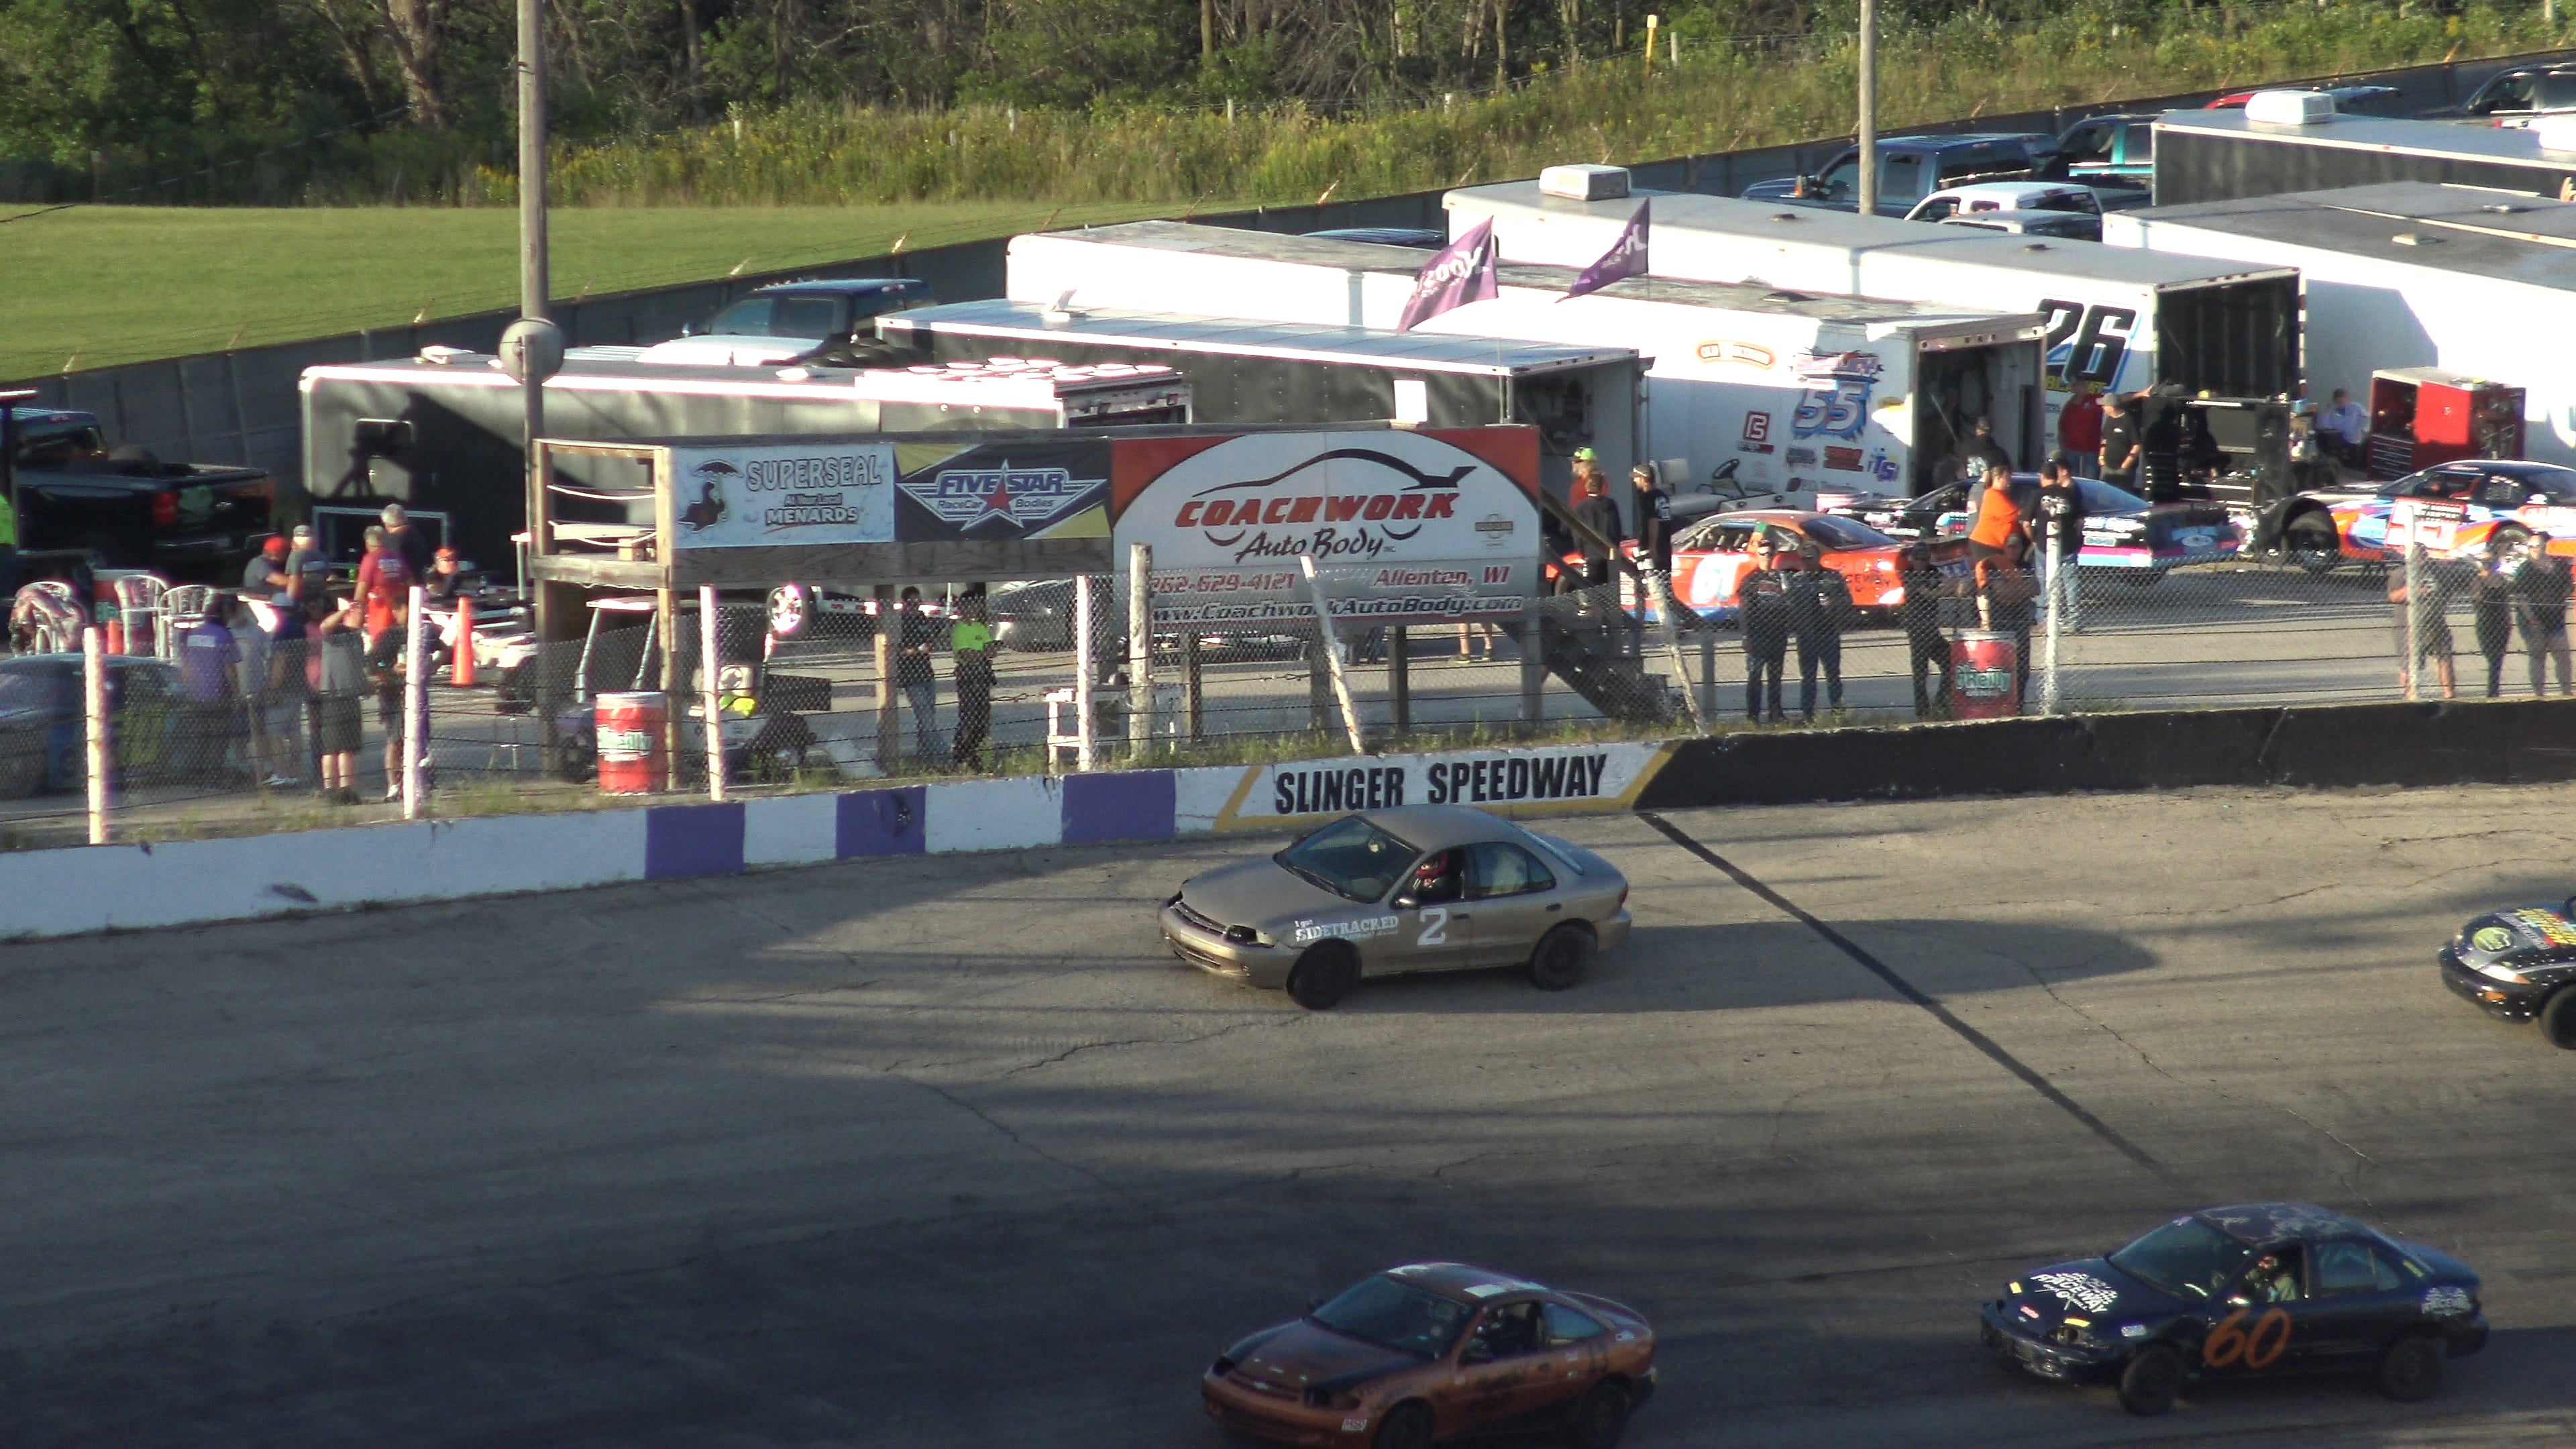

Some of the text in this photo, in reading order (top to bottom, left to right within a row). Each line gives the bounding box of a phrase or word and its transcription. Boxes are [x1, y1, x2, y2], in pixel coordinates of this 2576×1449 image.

[2037, 298, 2137, 387] 26
[1793, 379, 1865, 433] 55
[747, 455, 882, 492] SUPERSEAL
[940, 473, 1065, 496] FIVE STAR
[765, 506, 859, 526] MENARDS
[1174, 492, 1461, 528] COACHWORK
[1234, 530, 1306, 564] Auto
[1311, 525, 1385, 561] Body
[1483, 566, 1511, 584] WI
[1276, 753, 1607, 815] SLINGER SPEEDWAY
[1295, 915, 1399, 943] SIDETRACKED
[1416, 906, 1447, 946] 2
[2030, 1273, 2108, 1313] RACEWAY
[2202, 1308, 2293, 1369] 60
